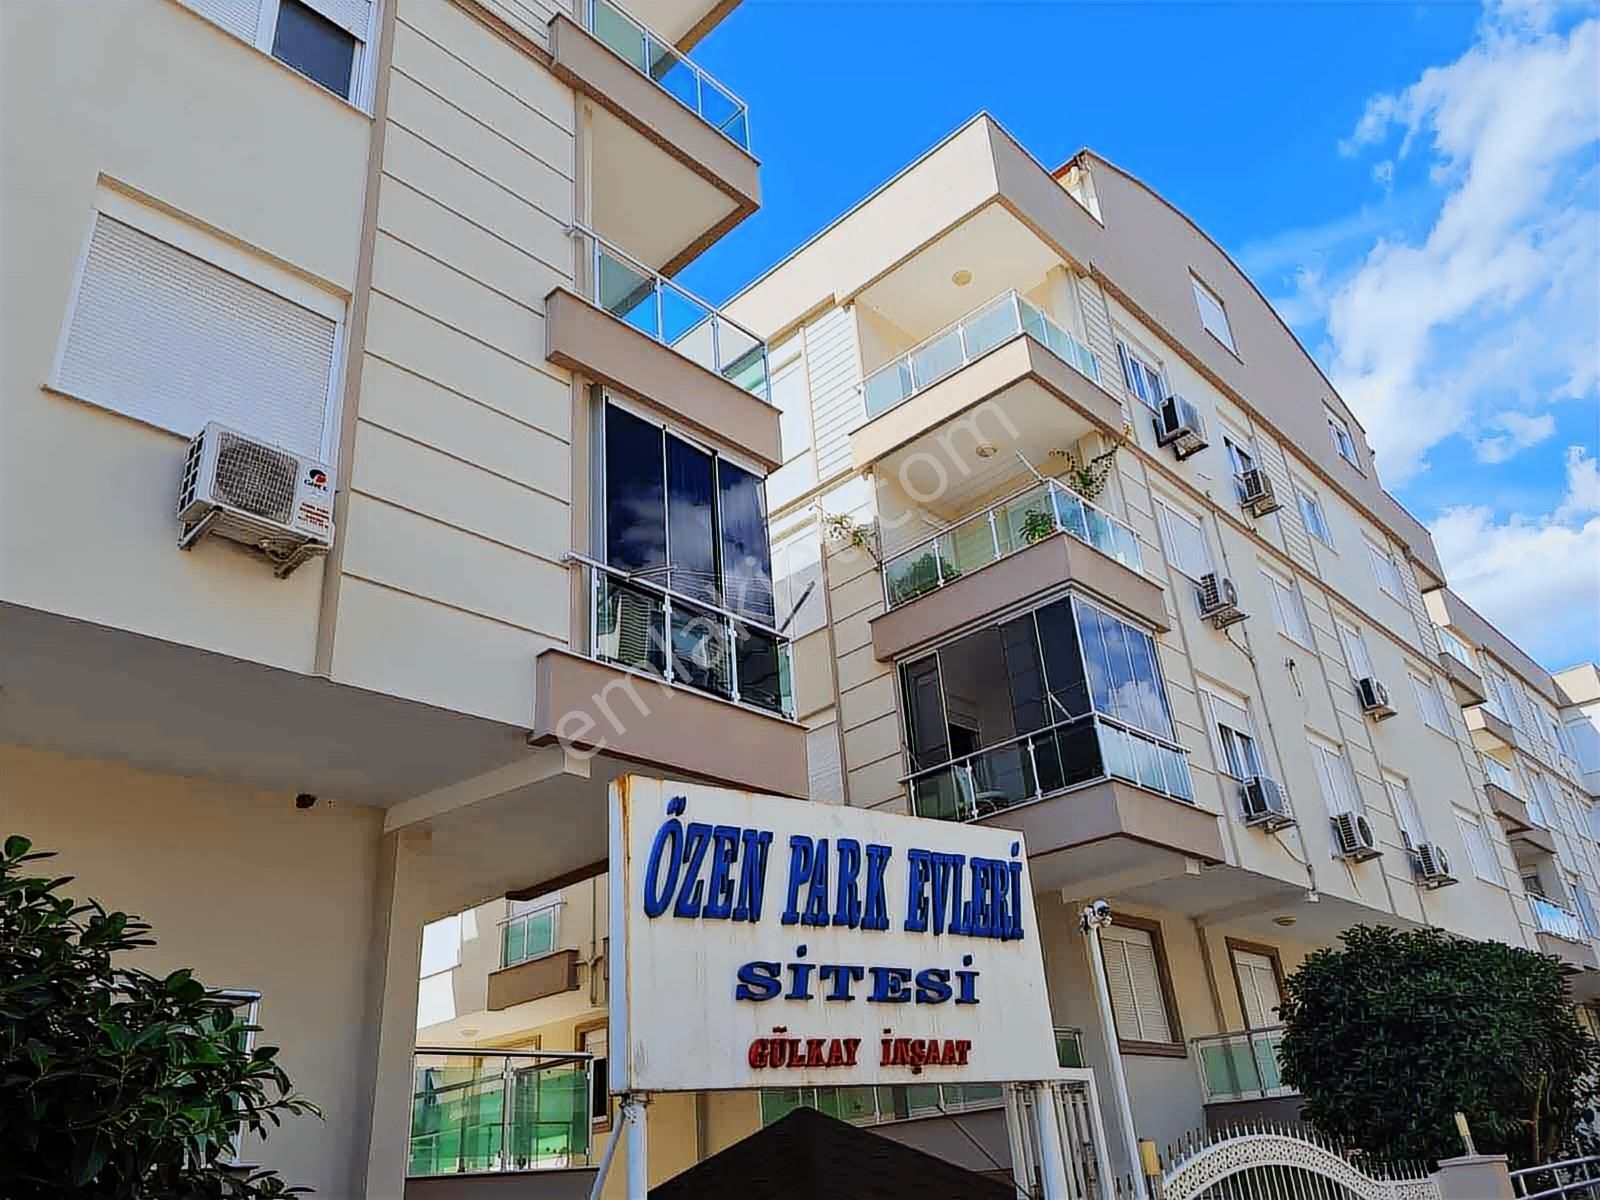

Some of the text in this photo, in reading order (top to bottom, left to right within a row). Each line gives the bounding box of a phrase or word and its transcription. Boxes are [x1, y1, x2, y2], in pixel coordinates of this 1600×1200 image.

[643, 796, 1024, 941] ÖZEN PARK EVLERİ
[735, 944, 980, 1005] SİTESİ
[748, 1026, 972, 1074] GÜLKAY İNŞAAT
